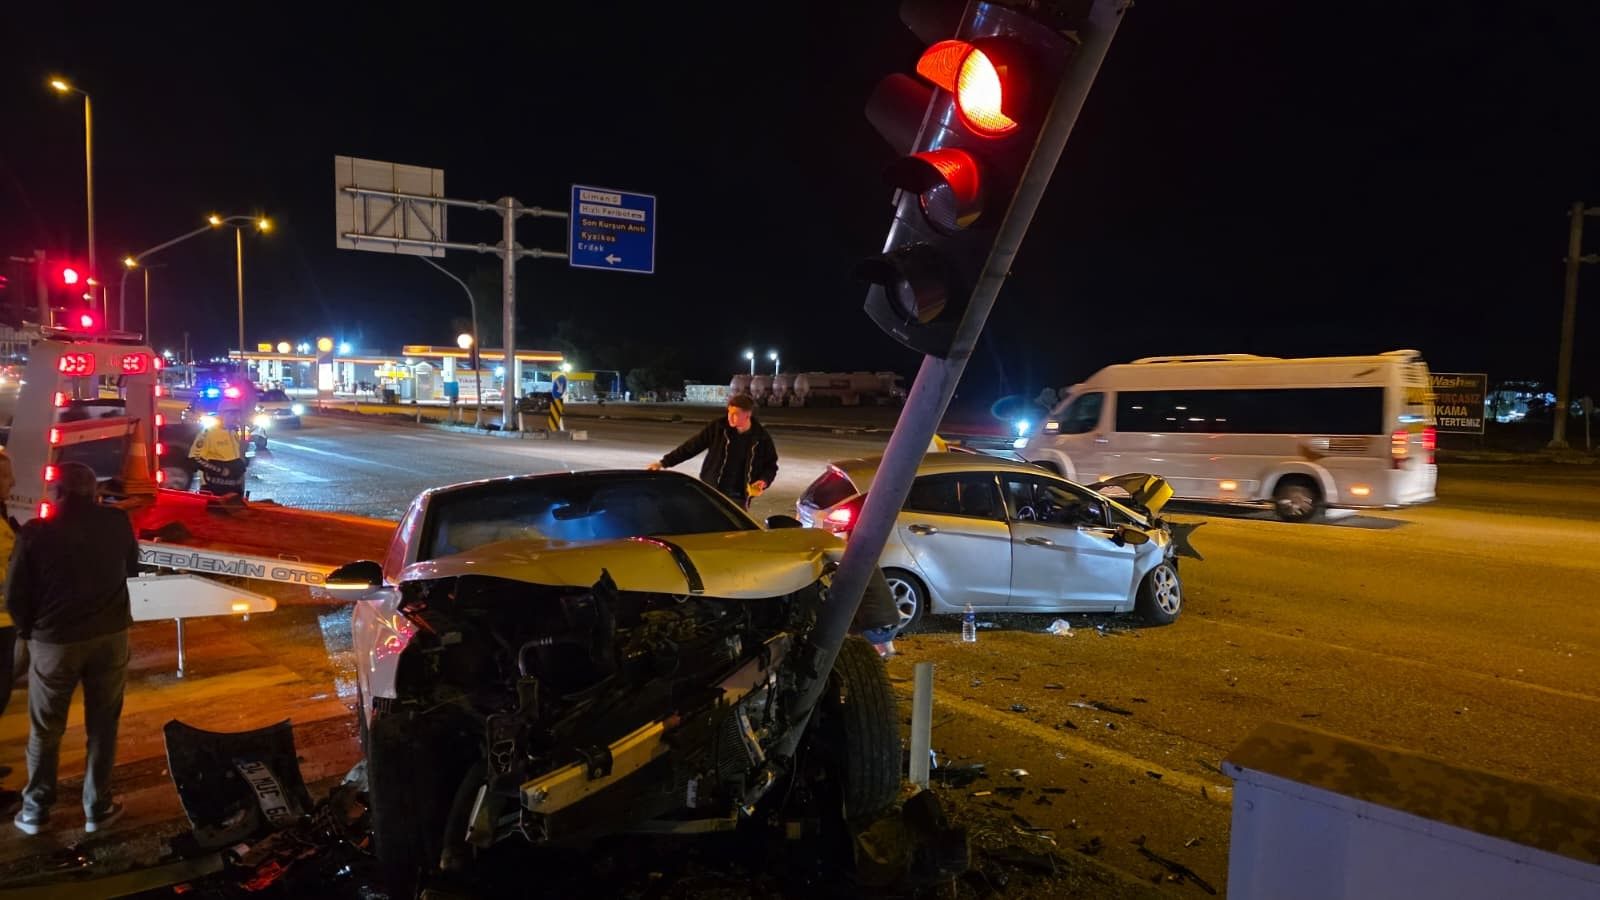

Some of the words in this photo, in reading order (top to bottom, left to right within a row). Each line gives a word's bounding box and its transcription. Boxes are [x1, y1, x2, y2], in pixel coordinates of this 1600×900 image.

[582, 193, 610, 202] Liman
[582, 218, 598, 226] Son
[581, 231, 616, 242] Kyzikos
[577, 242, 604, 252] Erdek
[139, 549, 266, 578] YEDİEMİN
[270, 567, 327, 585] OTO
